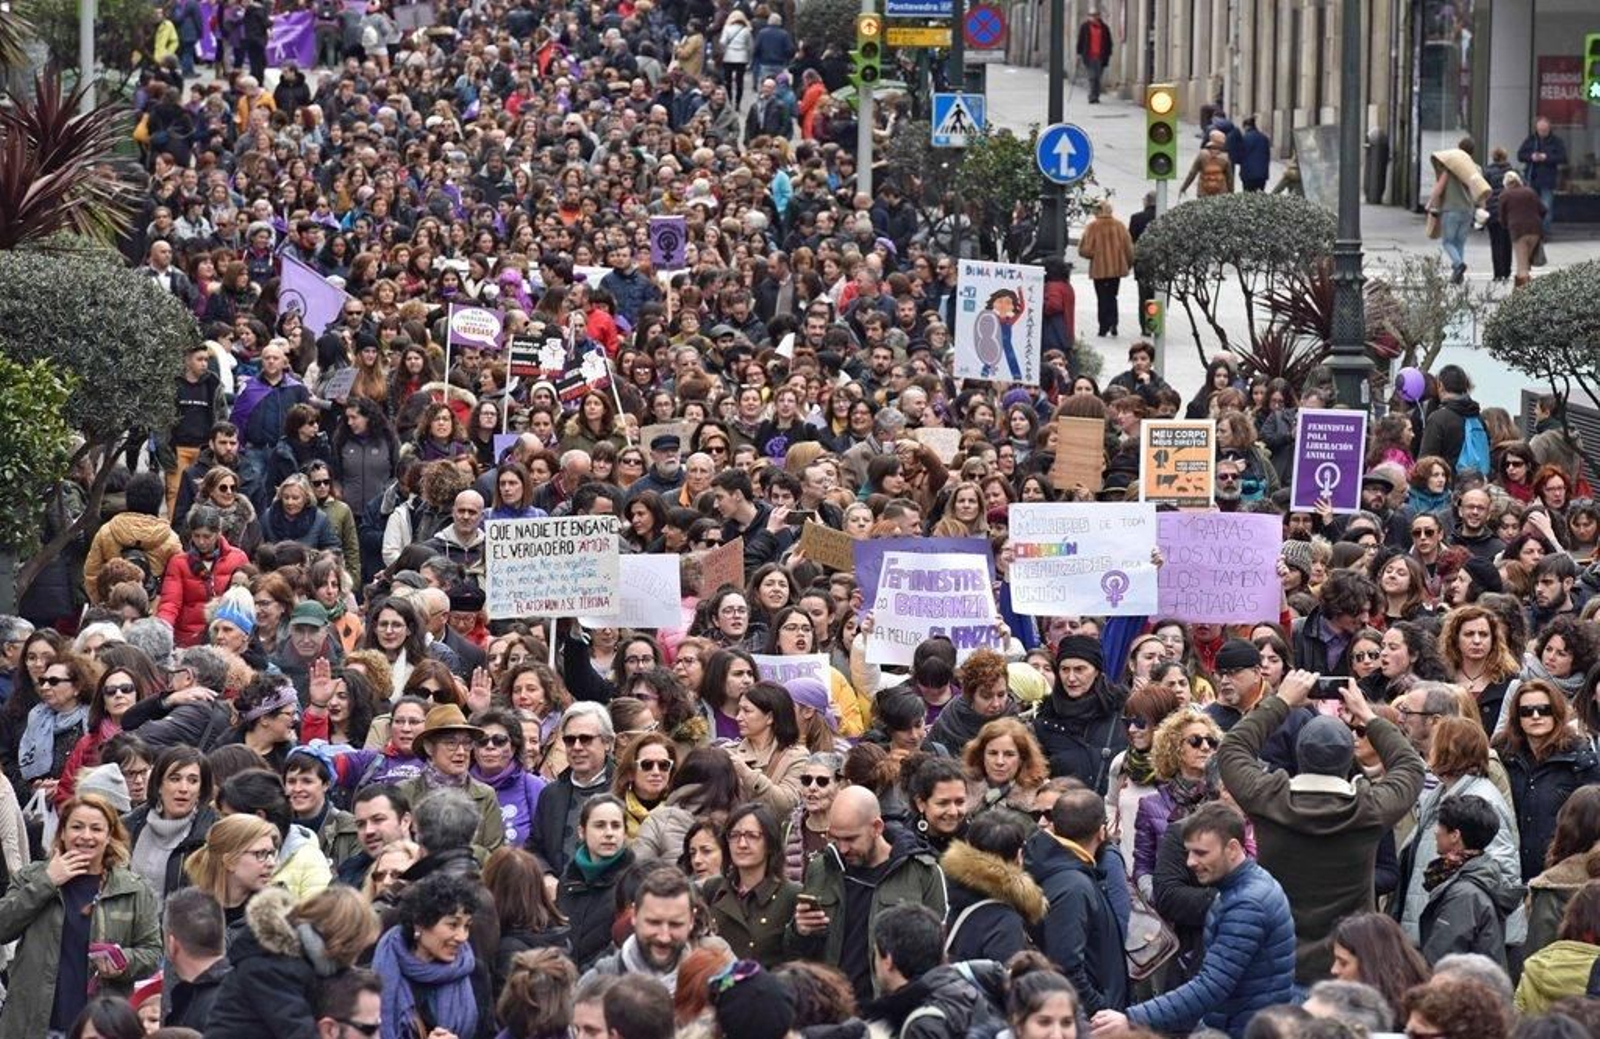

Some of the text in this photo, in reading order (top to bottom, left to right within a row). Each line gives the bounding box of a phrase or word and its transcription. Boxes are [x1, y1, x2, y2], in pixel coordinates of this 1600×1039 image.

[456, 325, 494, 337] LIBERDADE
[1152, 430, 1207, 438] MEU CORPO
[1307, 423, 1355, 432] FEMINISTAS
[1307, 432, 1327, 440] POLA
[1305, 441, 1353, 450] LIBERACIÓN
[1305, 451, 1335, 460] ANIMAL
[490, 517, 618, 541] QUE NADIE TE ENGAÑE
[1158, 515, 1254, 541] E MIRARAS
[493, 543, 507, 560] EL
[509, 540, 575, 559] VERDADERO
[1209, 545, 1265, 566] NOSOS
[882, 557, 986, 592] FEMINISTAS
[894, 593, 989, 619] BARBANZA
[875, 625, 884, 640] A
[888, 627, 923, 646] MELLOR
